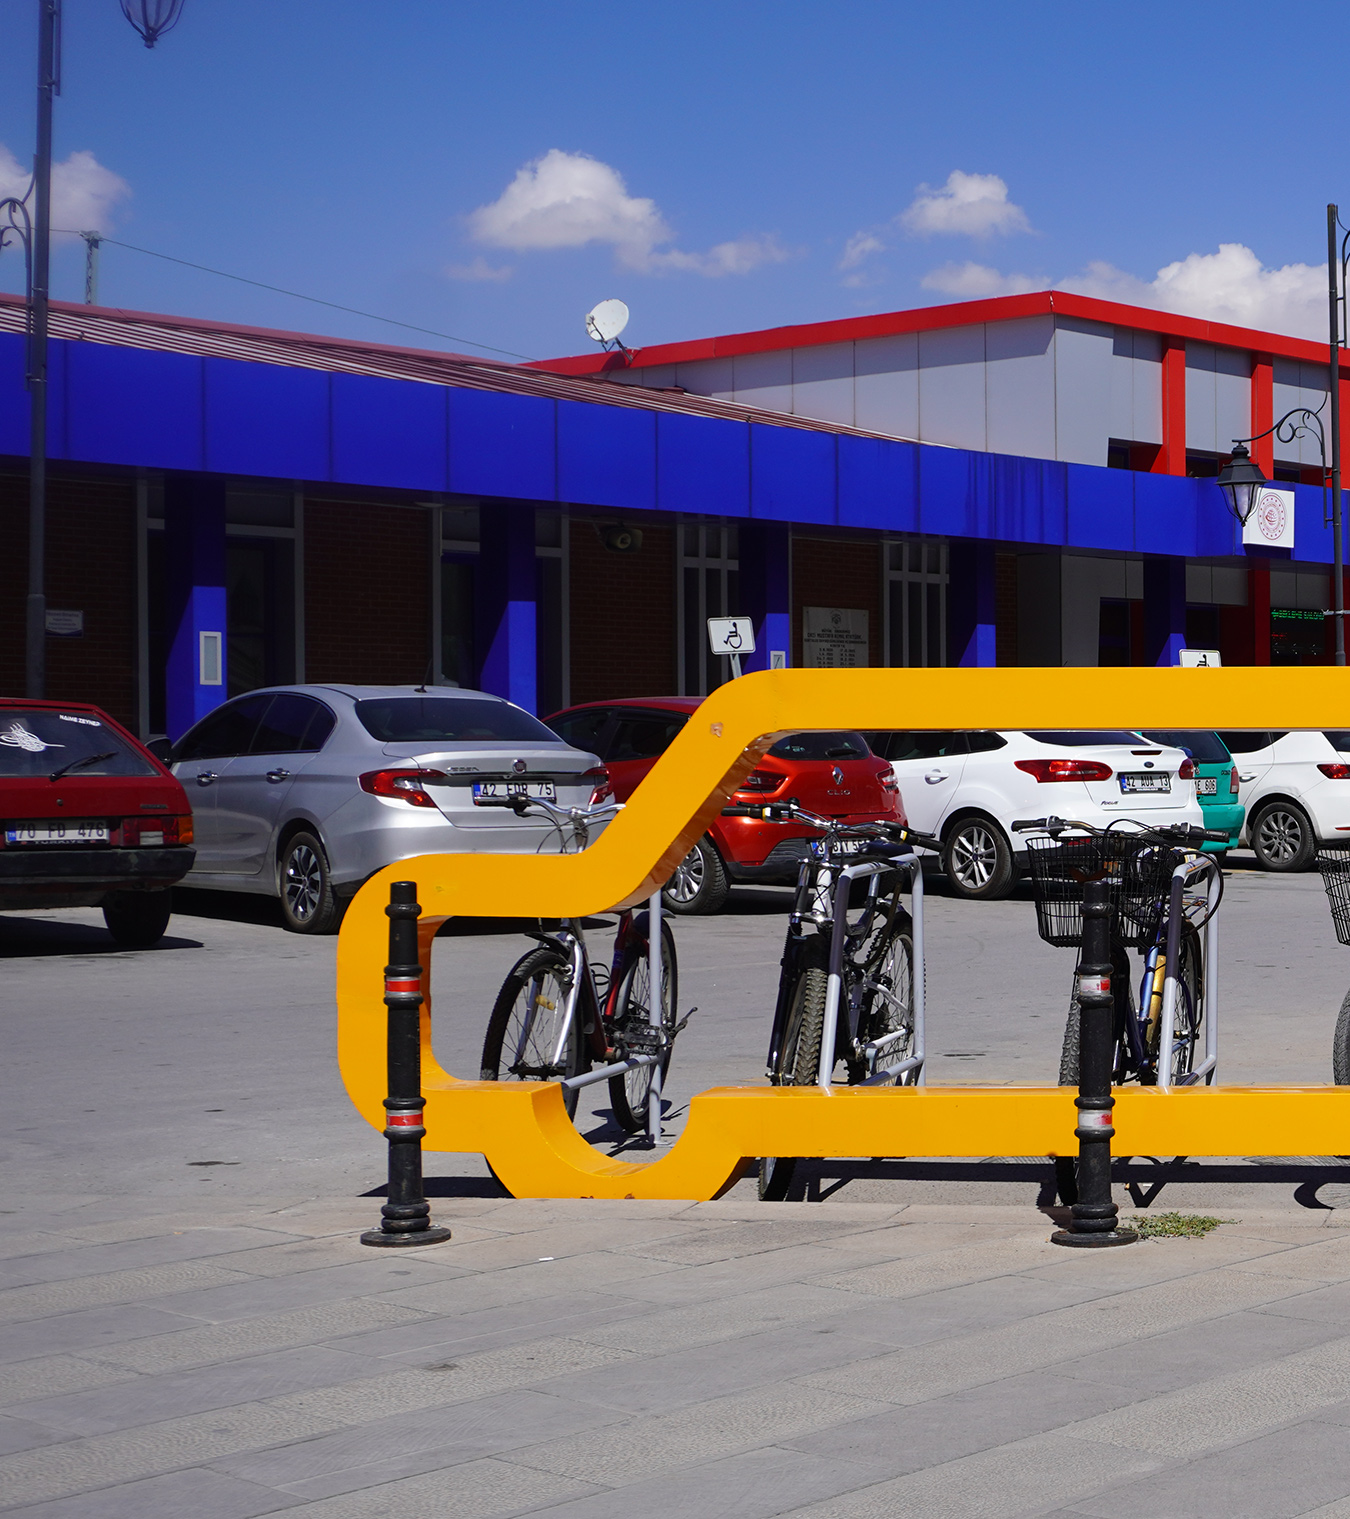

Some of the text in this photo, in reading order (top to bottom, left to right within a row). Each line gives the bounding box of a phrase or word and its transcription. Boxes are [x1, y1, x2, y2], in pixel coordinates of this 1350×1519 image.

[1126, 776, 1135, 787] 42
[1159, 775, 1168, 786] 13
[482, 783, 496, 796] 42
[537, 782, 552, 795] 75
[18, 822, 36, 839] 70
[48, 822, 66, 838] FD
[78, 822, 104, 837] 476
